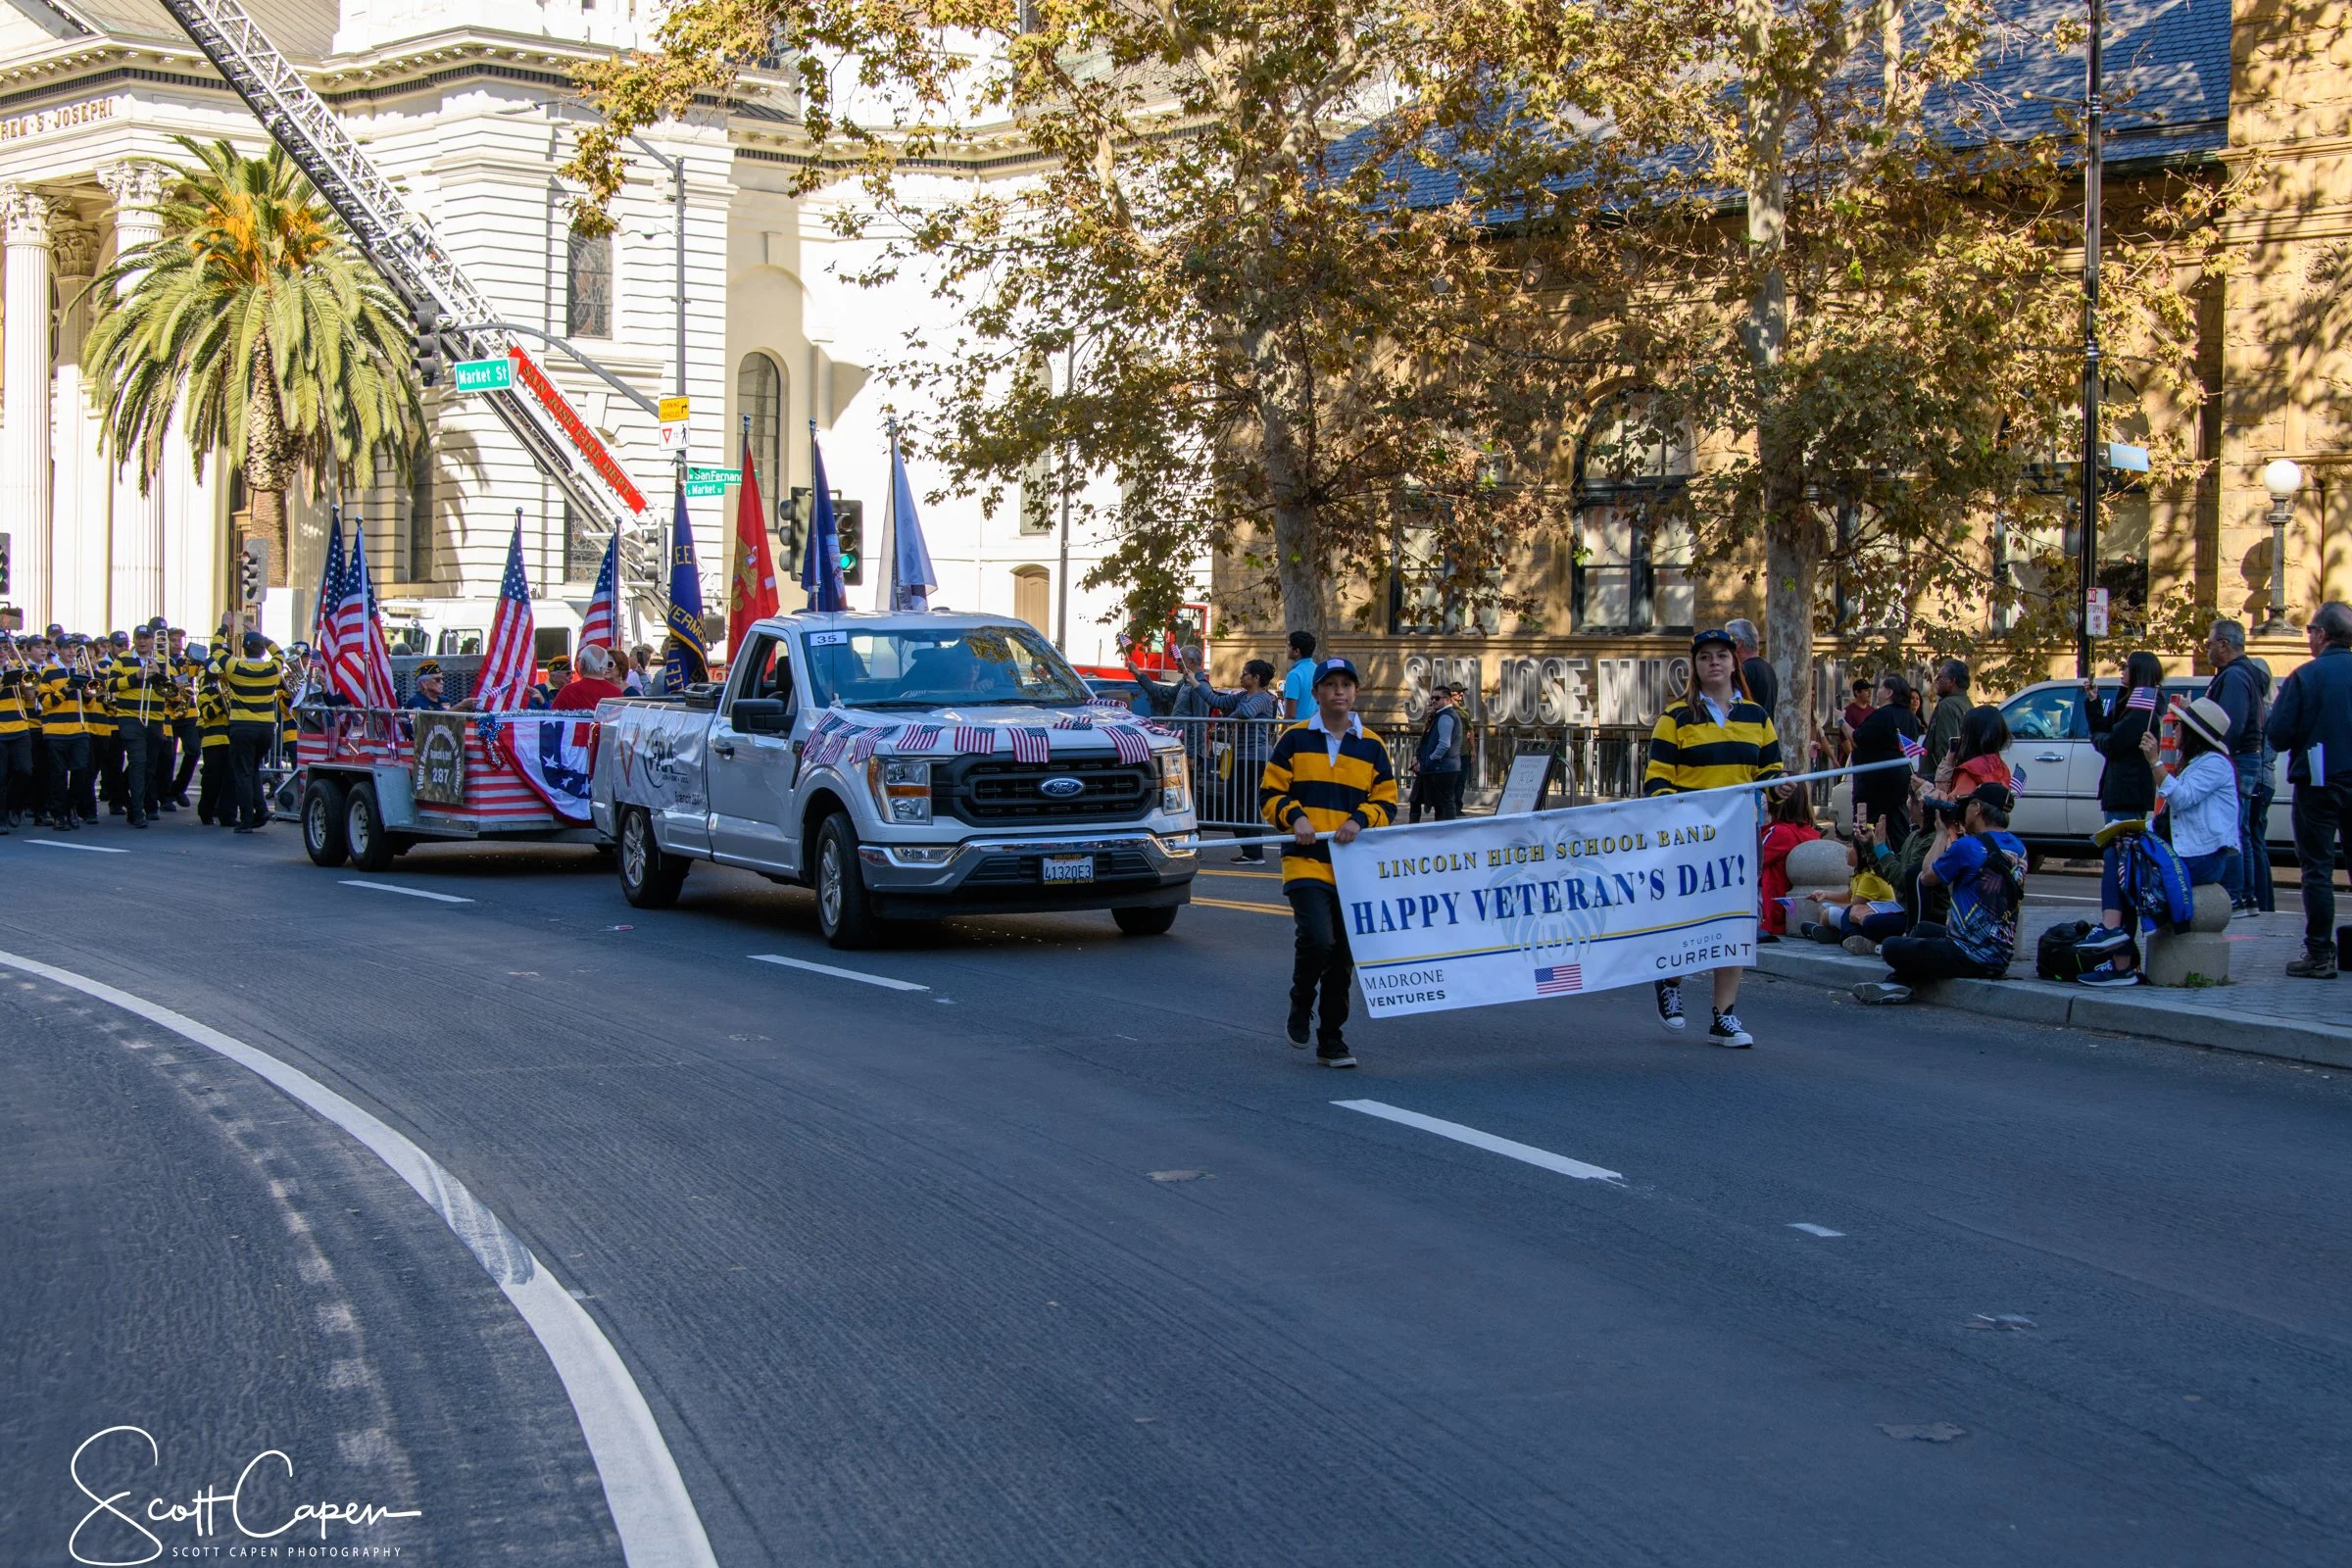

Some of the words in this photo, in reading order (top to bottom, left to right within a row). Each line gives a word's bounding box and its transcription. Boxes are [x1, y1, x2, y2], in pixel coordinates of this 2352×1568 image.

[54, 98, 113, 128] JOSEPHI
[458, 368, 491, 385] Market
[495, 365, 508, 381] St
[521, 365, 548, 396] SAN
[546, 393, 576, 429] JOSE
[574, 426, 602, 464] FIRE
[662, 411, 680, 419] VEHICLES
[692, 483, 716, 495] Market
[2088, 590, 2096, 602] NO
[816, 634, 837, 644] 35
[1487, 658, 1596, 725] JOSE
[432, 767, 450, 784] 287
[1052, 782, 1075, 793] Ford
[1377, 852, 1478, 879] LINCOLN
[1488, 844, 1545, 867] HIGH
[1556, 833, 1647, 860] SCHOOL
[1657, 823, 1716, 849] BAND
[1045, 864, 1092, 880] 41320E3
[1349, 891, 1461, 936] HAPPY
[1472, 867, 1666, 921] VETERAN'S
[1677, 854, 1745, 898] DAY!
[1682, 933, 1723, 948] STUDIO
[1655, 943, 1752, 970] CURRENT
[1363, 968, 1445, 991] MADRONE
[1368, 990, 1446, 1007] VENTURES
